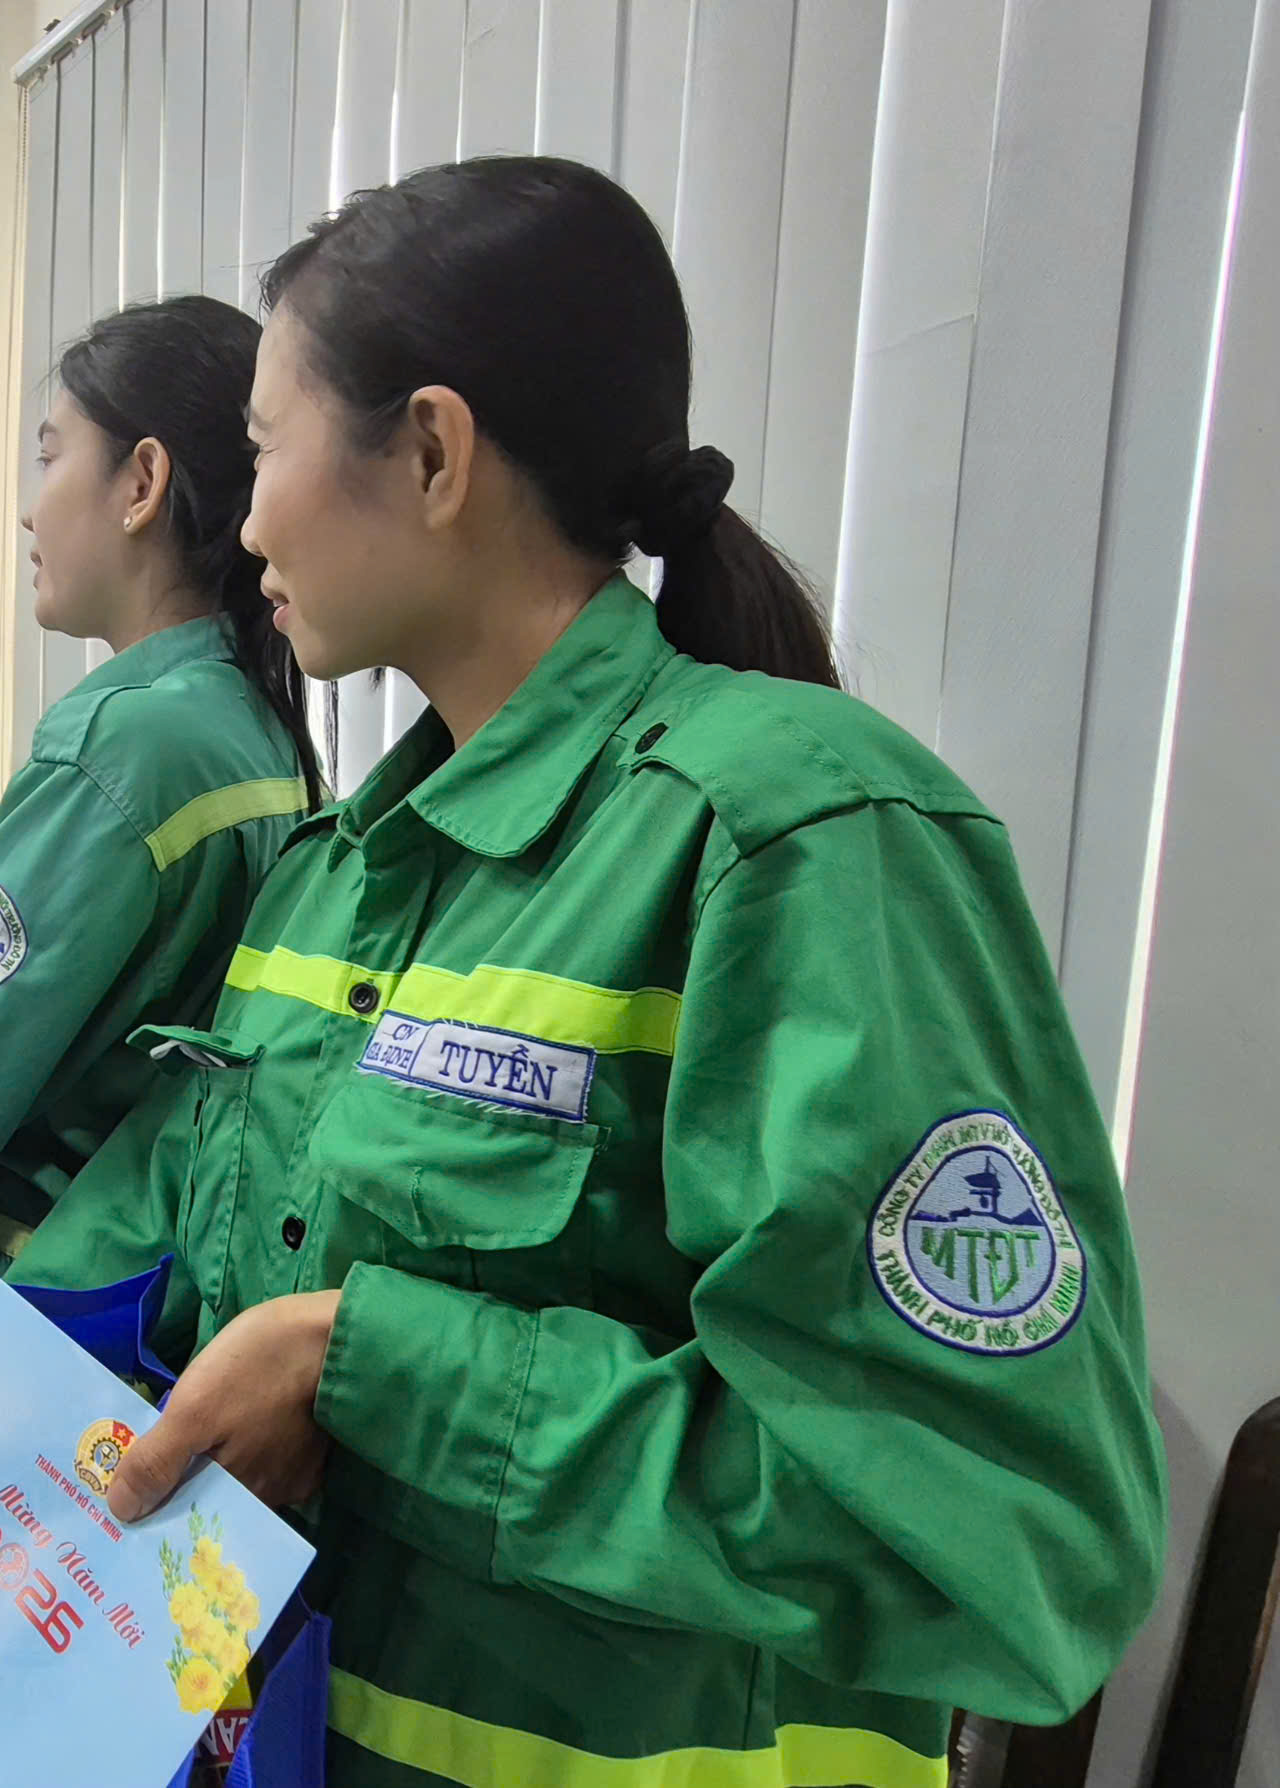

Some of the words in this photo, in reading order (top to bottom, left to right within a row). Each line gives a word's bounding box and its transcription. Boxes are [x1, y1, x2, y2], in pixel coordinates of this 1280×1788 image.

[438, 1040, 558, 1101] TUYỀN
[35, 1453, 62, 1483] THÀNH
[58, 1477, 81, 1499] PHỐ
[99, 1519, 123, 1542] MINH
[56, 1541, 106, 1606] Năm
[102, 1602, 145, 1649] Mới
